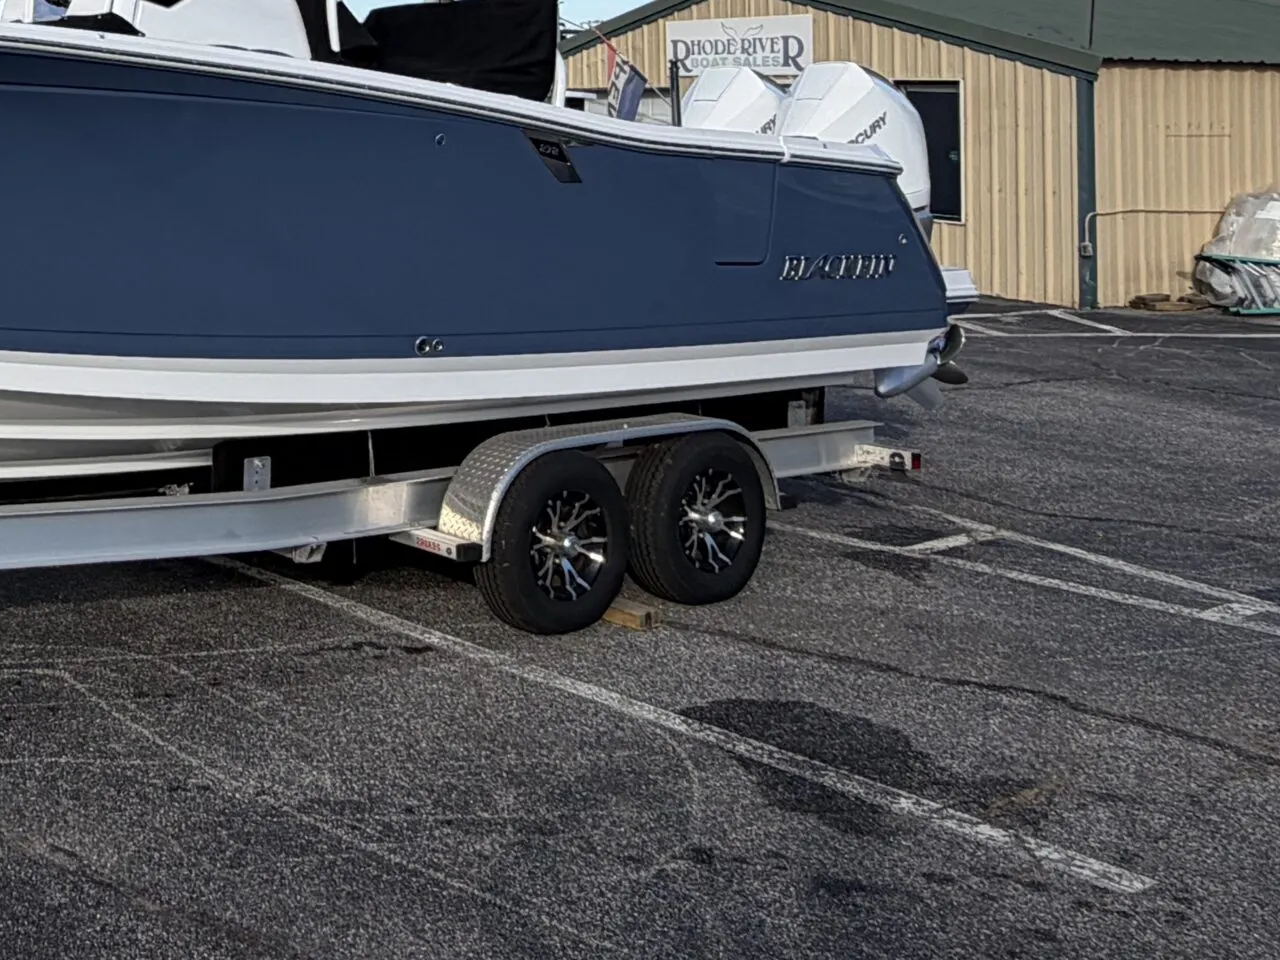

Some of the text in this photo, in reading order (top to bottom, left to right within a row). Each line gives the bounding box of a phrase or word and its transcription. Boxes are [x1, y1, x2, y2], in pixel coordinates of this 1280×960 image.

[670, 35, 805, 74] RHODE RIVER
[690, 55, 781, 69] BOAT SALES
